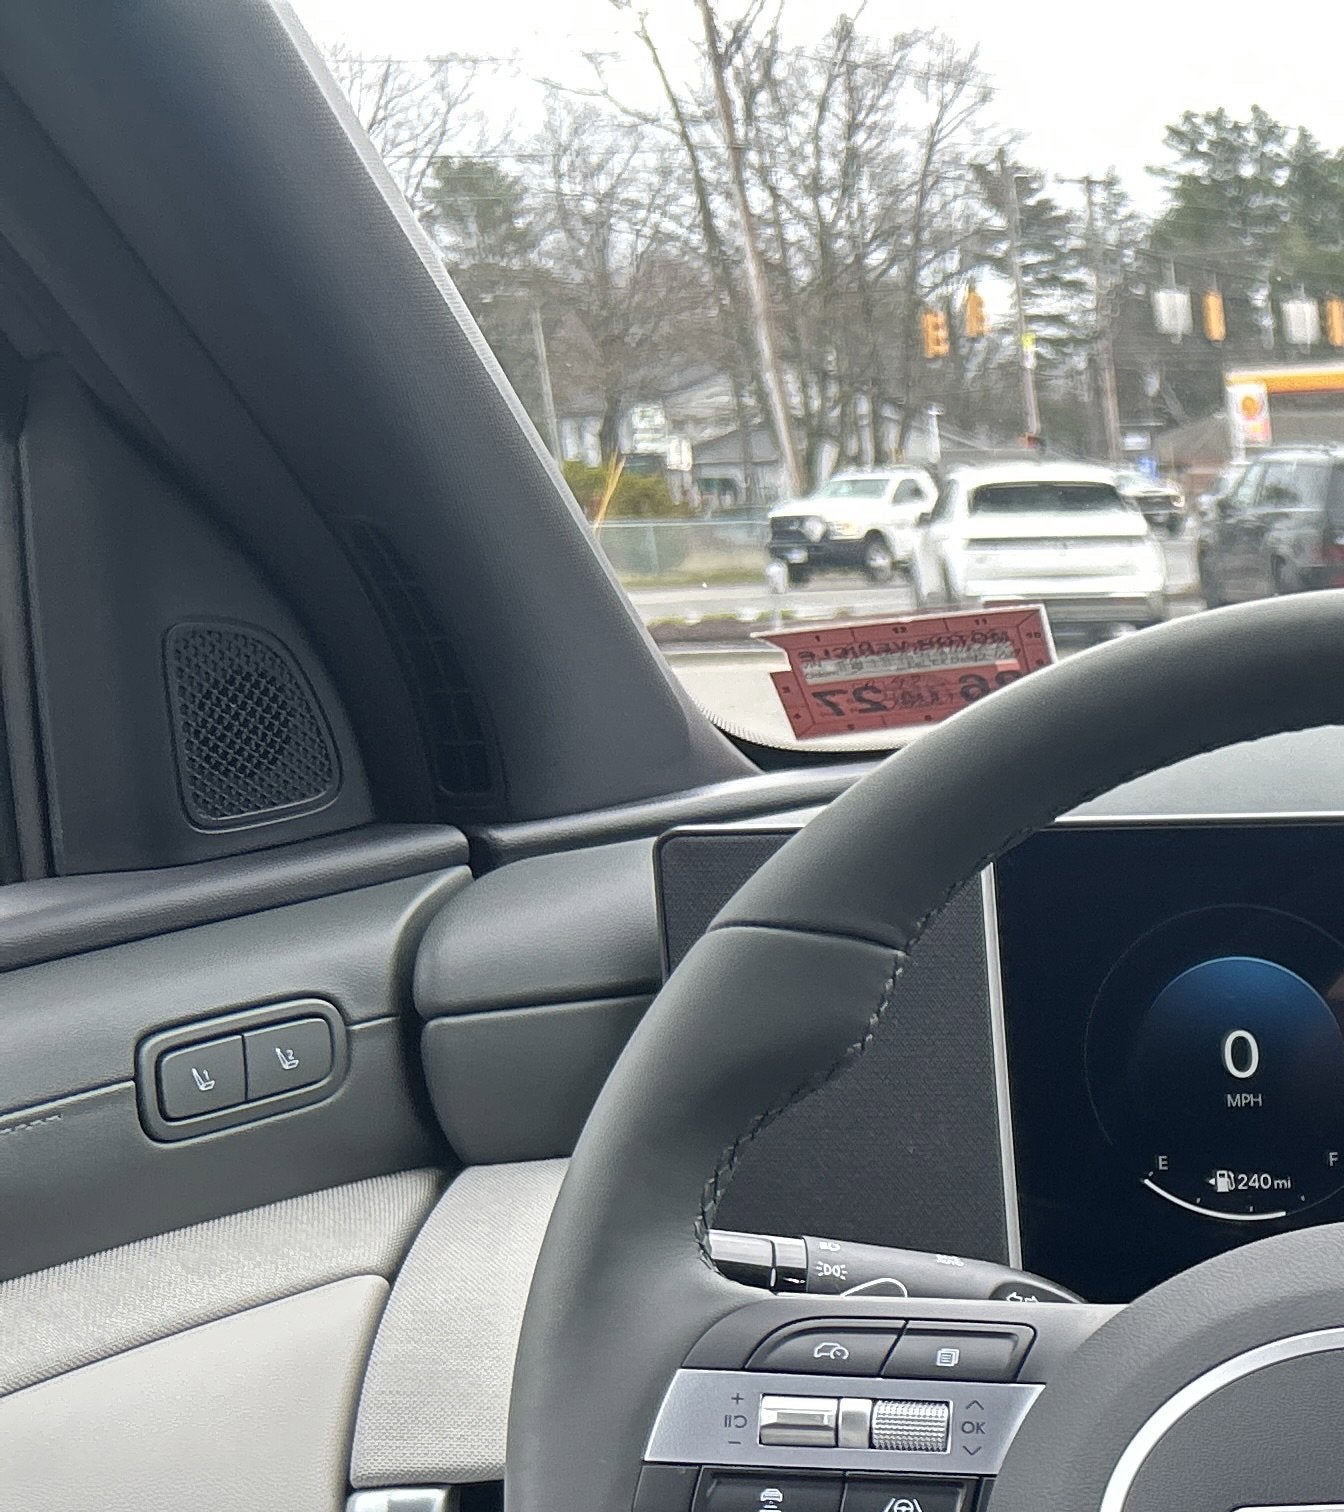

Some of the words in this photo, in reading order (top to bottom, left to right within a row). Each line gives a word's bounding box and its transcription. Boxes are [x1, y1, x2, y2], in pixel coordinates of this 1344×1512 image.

[1222, 1029, 1260, 1079] 0
[1227, 1094, 1262, 1107] MPH
[1159, 1156, 1168, 1169] E
[1329, 1152, 1338, 1166] F
[1237, 1174, 1271, 1190] 240
[1274, 1177, 1291, 1189] mi
[961, 1420, 985, 1434] OK
